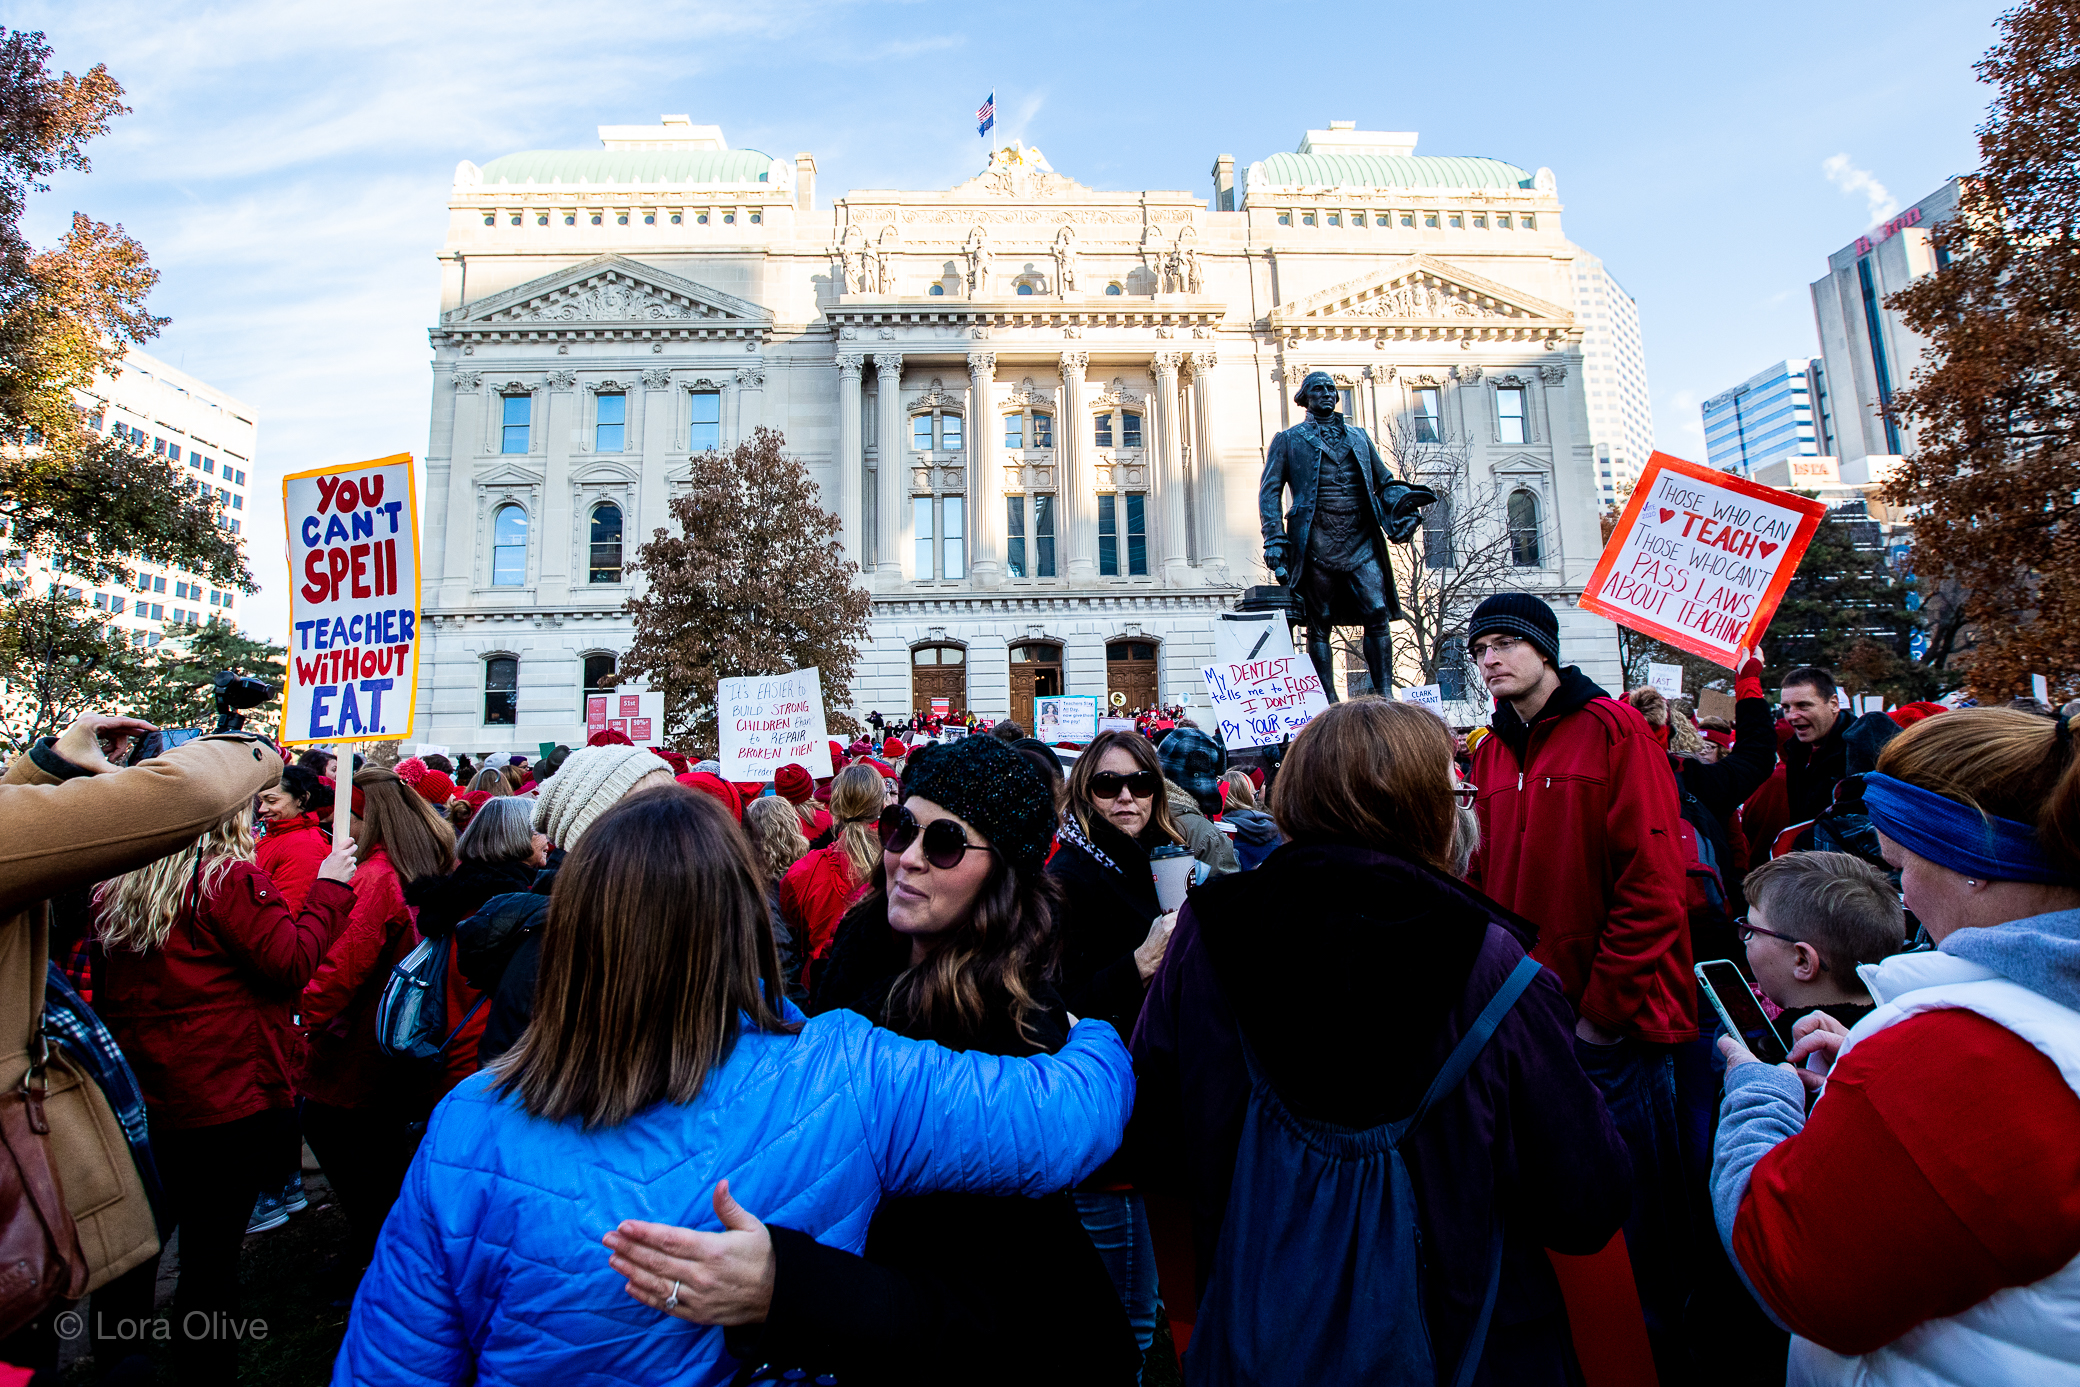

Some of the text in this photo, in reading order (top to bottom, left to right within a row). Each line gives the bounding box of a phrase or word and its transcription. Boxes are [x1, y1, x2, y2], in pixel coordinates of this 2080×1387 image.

[316, 474, 384, 515] YOU
[1642, 511, 1657, 519] 2020
[1658, 476, 1791, 541] THOSE WHO CAN
[302, 501, 402, 548] CAN'T
[1681, 510, 1759, 560] TEACH
[1634, 522, 1773, 591] THOSE WHO CAN'T
[1630, 552, 1755, 618] PASS LAWS
[1602, 571, 1750, 645] ABOUT TEACHING
[295, 609, 415, 650] TEACHER
[1204, 658, 1295, 695] My DENTIST
[1652, 677, 1672, 686] LAST
[757, 680, 794, 699] EASIER
[798, 680, 806, 696] to
[1212, 689, 1241, 704] tells
[1248, 688, 1265, 696] me
[1271, 683, 1282, 693] to
[1411, 690, 1432, 698] CLARK
[309, 678, 394, 738] E.A.T.
[732, 701, 809, 717] BUILD STRONG
[1240, 699, 1258, 712] I
[736, 717, 790, 731] CHILDREN
[1221, 720, 1241, 742] By
[1245, 714, 1280, 734] YOUR
[749, 730, 806, 744] to REPAIR
[1251, 733, 1280, 745] he's
[738, 747, 781, 759] BROKEN
